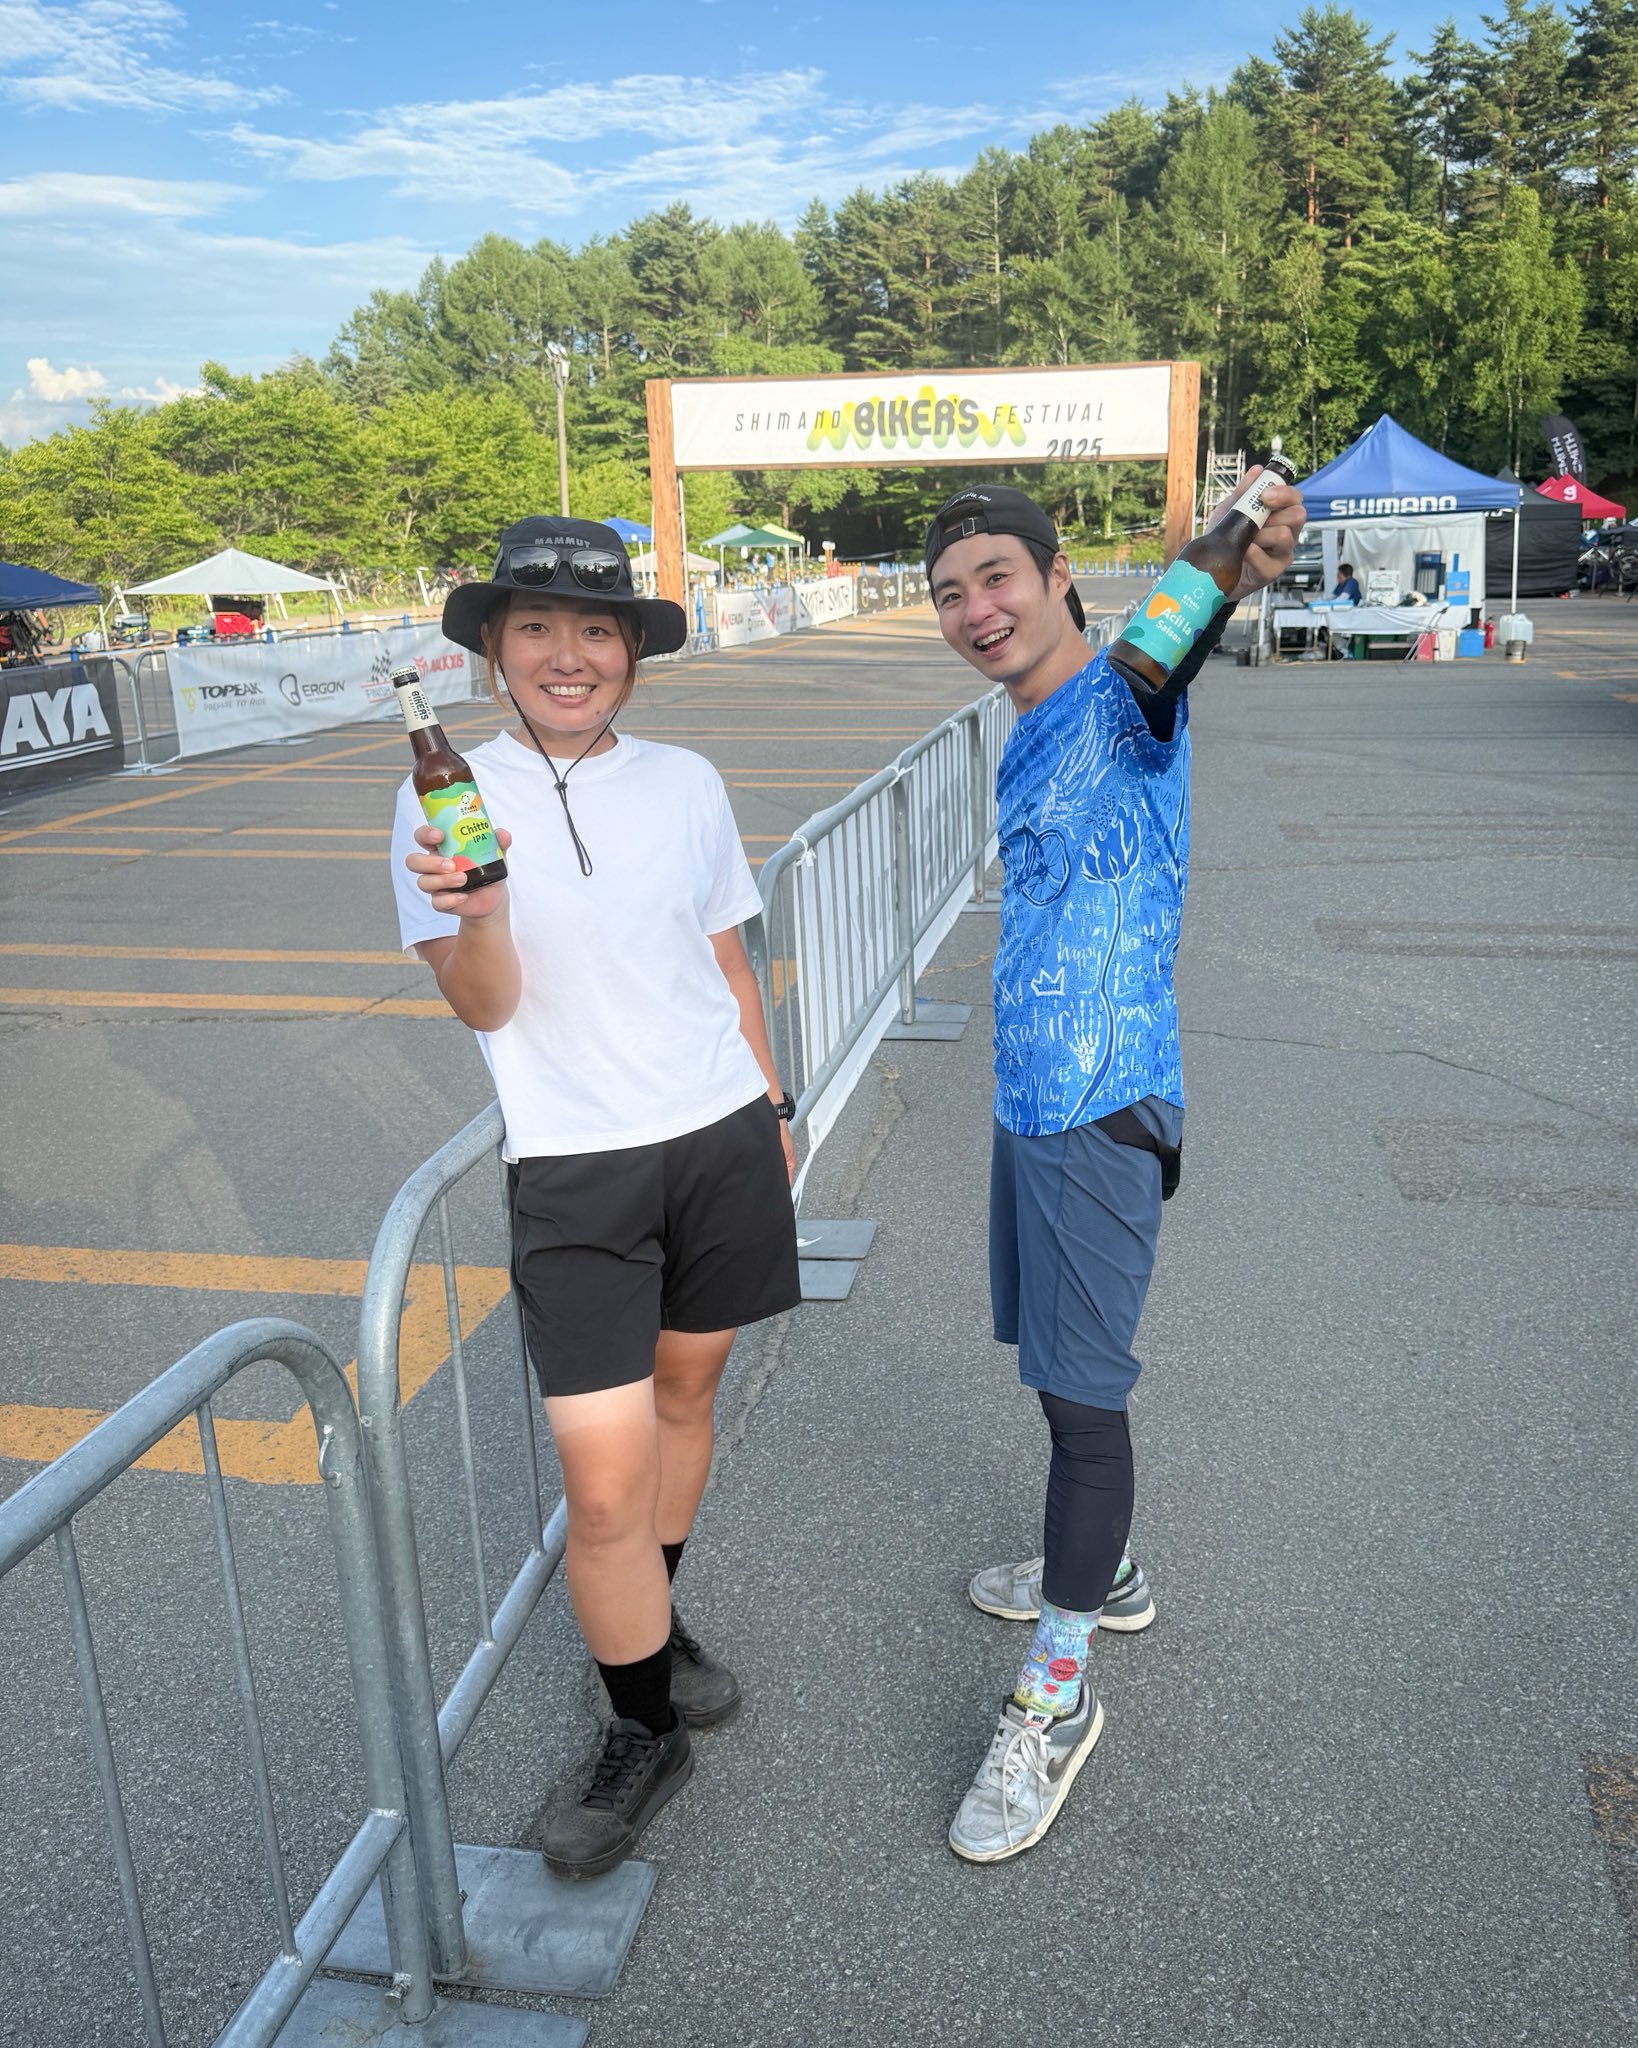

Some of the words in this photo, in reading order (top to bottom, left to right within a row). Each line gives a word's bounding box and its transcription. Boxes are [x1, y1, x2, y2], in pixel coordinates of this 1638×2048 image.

[735, 410, 841, 432] SHIMANO
[854, 399, 979, 437] BIKER'S
[992, 402, 1104, 425] FESTIVAL
[1045, 437, 1104, 463] 2025
[1329, 495, 1458, 516] SHIMANO
[534, 536, 591, 548] MAMMUT
[1155, 619, 1182, 645] Saison
[1182, 621, 1192, 636] la
[198, 682, 263, 700] TOPEAK
[302, 680, 346, 697] ERGON
[460, 821, 489, 836] Chitto
[473, 833, 488, 844] IPA
[1031, 1714, 1047, 1724] NIKE
